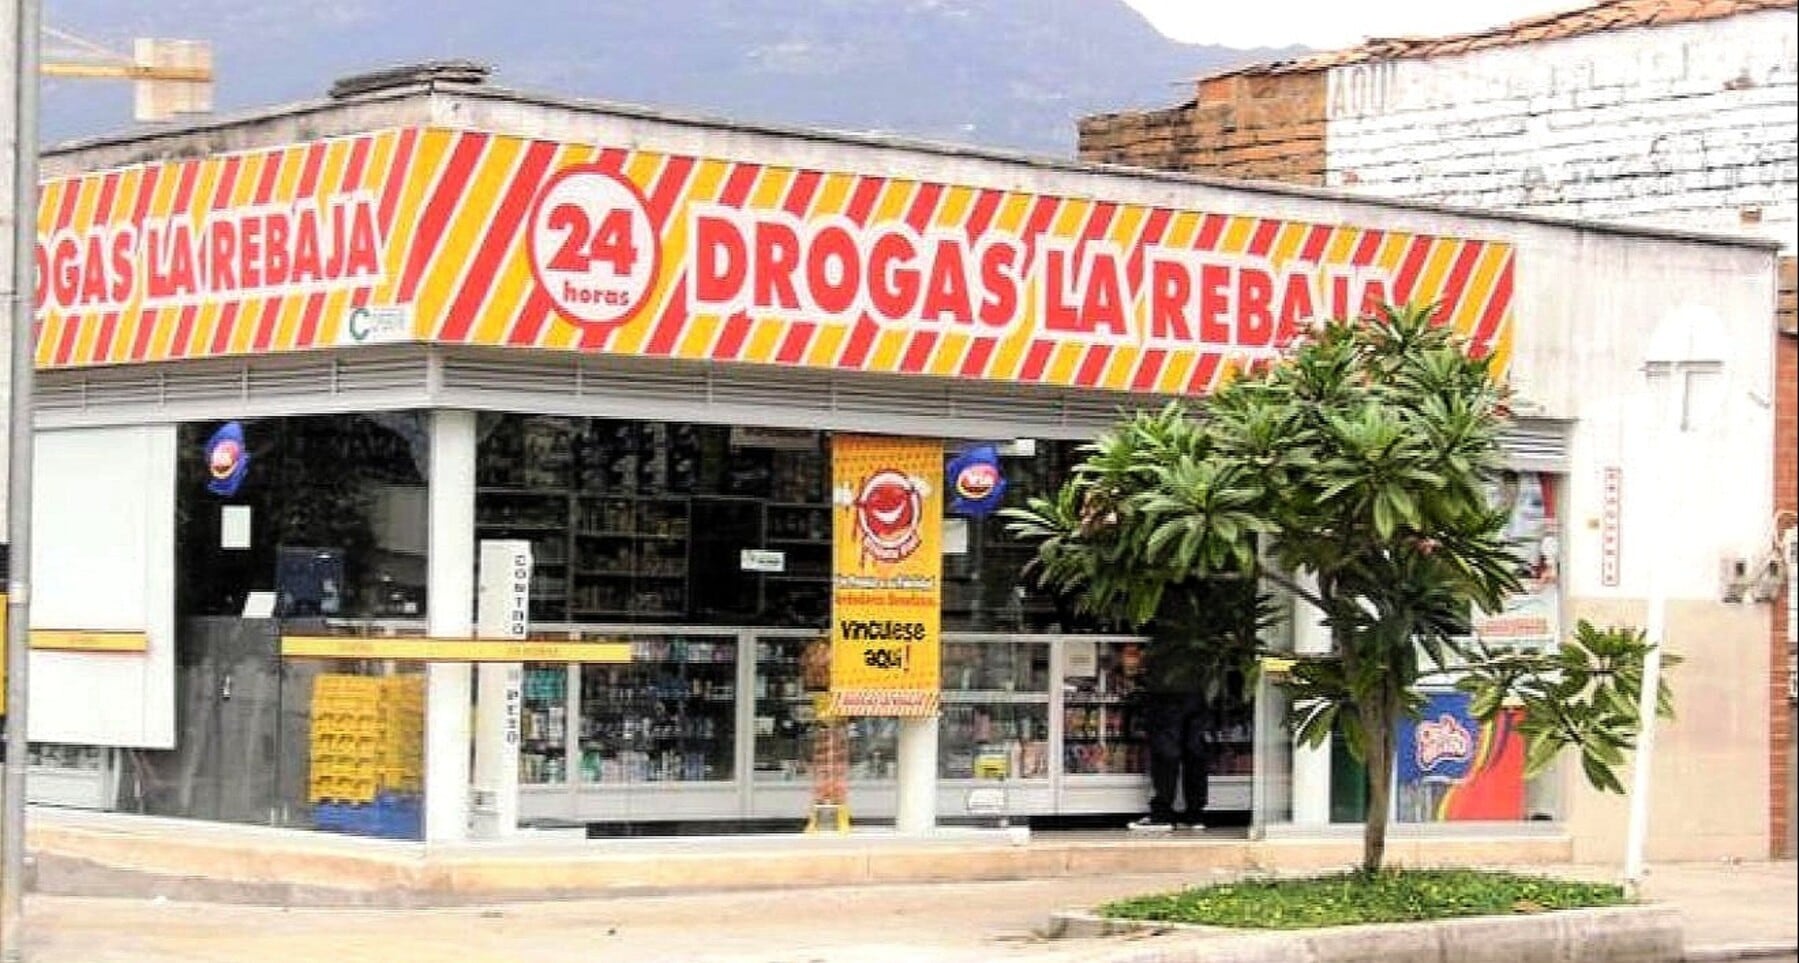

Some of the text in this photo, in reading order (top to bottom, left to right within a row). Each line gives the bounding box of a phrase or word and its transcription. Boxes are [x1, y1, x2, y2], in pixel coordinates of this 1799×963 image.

[34, 202, 380, 309] OGAS LA REBAJA
[546, 203, 638, 276] 24
[695, 216, 1019, 327] DROGAS
[1045, 249, 1126, 336] LA
[563, 281, 629, 306] horas
[512, 554, 527, 635] CONTRO
